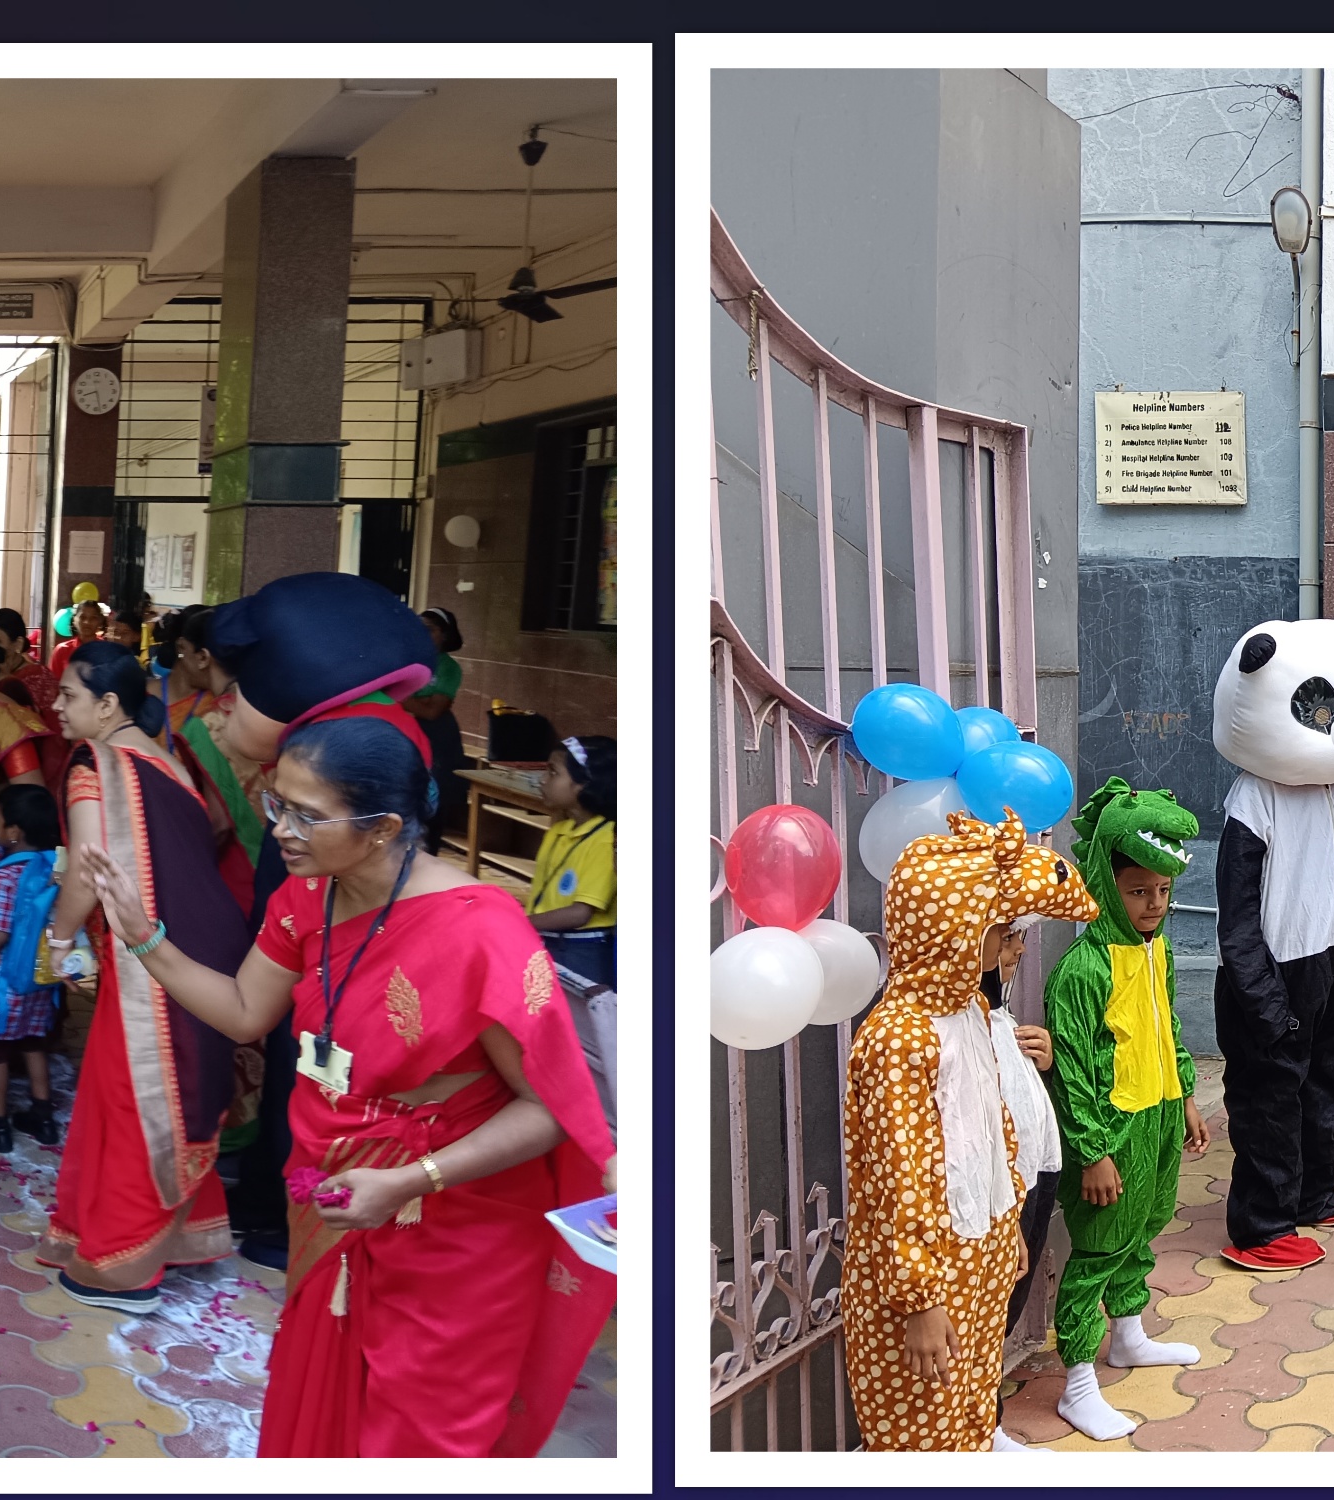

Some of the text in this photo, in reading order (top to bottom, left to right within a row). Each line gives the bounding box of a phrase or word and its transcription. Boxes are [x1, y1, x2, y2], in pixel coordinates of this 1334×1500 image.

[1133, 403, 1205, 414] Helpline Numbers
[1105, 424, 1112, 432] 1)
[1121, 423, 1140, 431] Police
[1141, 423, 1167, 432] Helpline
[1168, 423, 1193, 431] Number
[1121, 439, 1156, 447] Ambulance
[1157, 439, 1183, 447] Helpline
[1121, 455, 1148, 463] Hospital
[1149, 454, 1175, 463] Helpline
[1176, 454, 1200, 462] Number
[1105, 470, 1112, 478] 4)
[1136, 470, 1161, 479] Brigade
[1161, 470, 1188, 479] Helpline
[1121, 484, 1139, 493] Child
[1139, 485, 1166, 495] Helpline
[1167, 485, 1192, 493] Number
